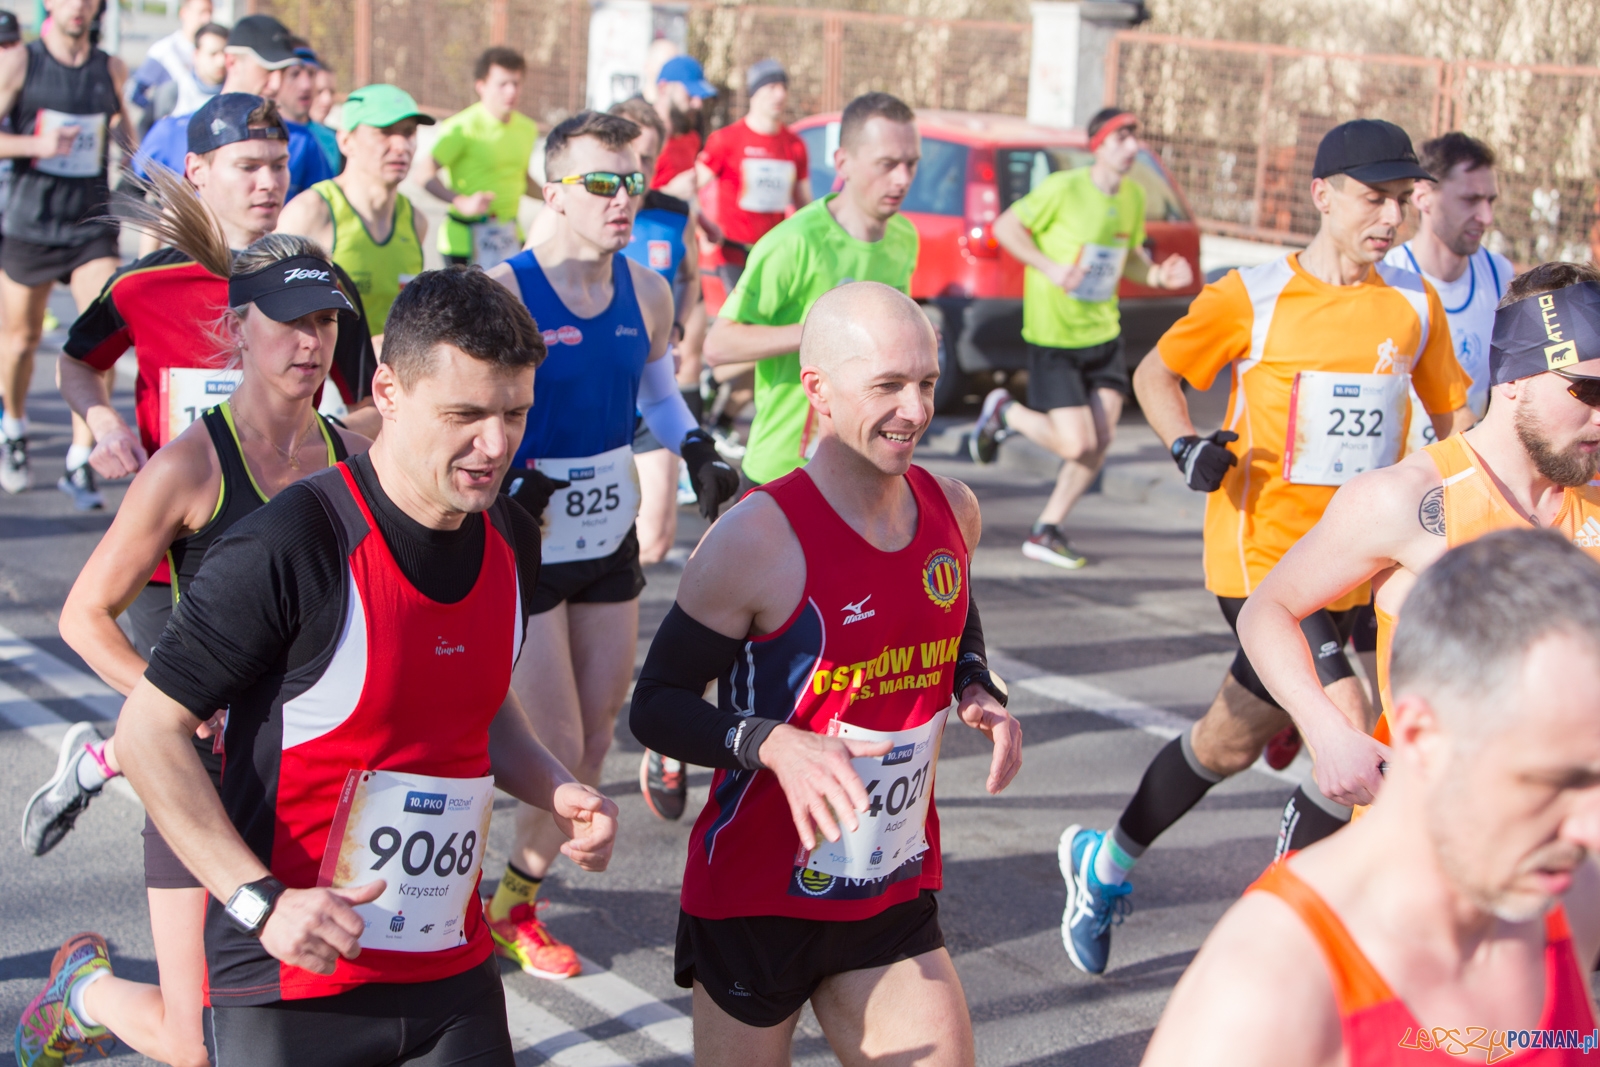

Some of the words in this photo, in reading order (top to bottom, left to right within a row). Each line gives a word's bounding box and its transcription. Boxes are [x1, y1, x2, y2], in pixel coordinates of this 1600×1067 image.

[1538, 294, 1563, 343] ATTIQ
[1327, 408, 1384, 437] 232
[1341, 442, 1369, 450] Marcin
[566, 483, 620, 517] 825
[928, 556, 956, 575] MARATON
[879, 669, 943, 696] MARATO
[866, 760, 930, 818] 4021
[410, 797, 422, 808] 10.
[423, 799, 443, 810] PKO
[884, 819, 908, 833] Adam
[369, 826, 477, 877] 9068
[398, 883, 450, 899] Krzysztof
